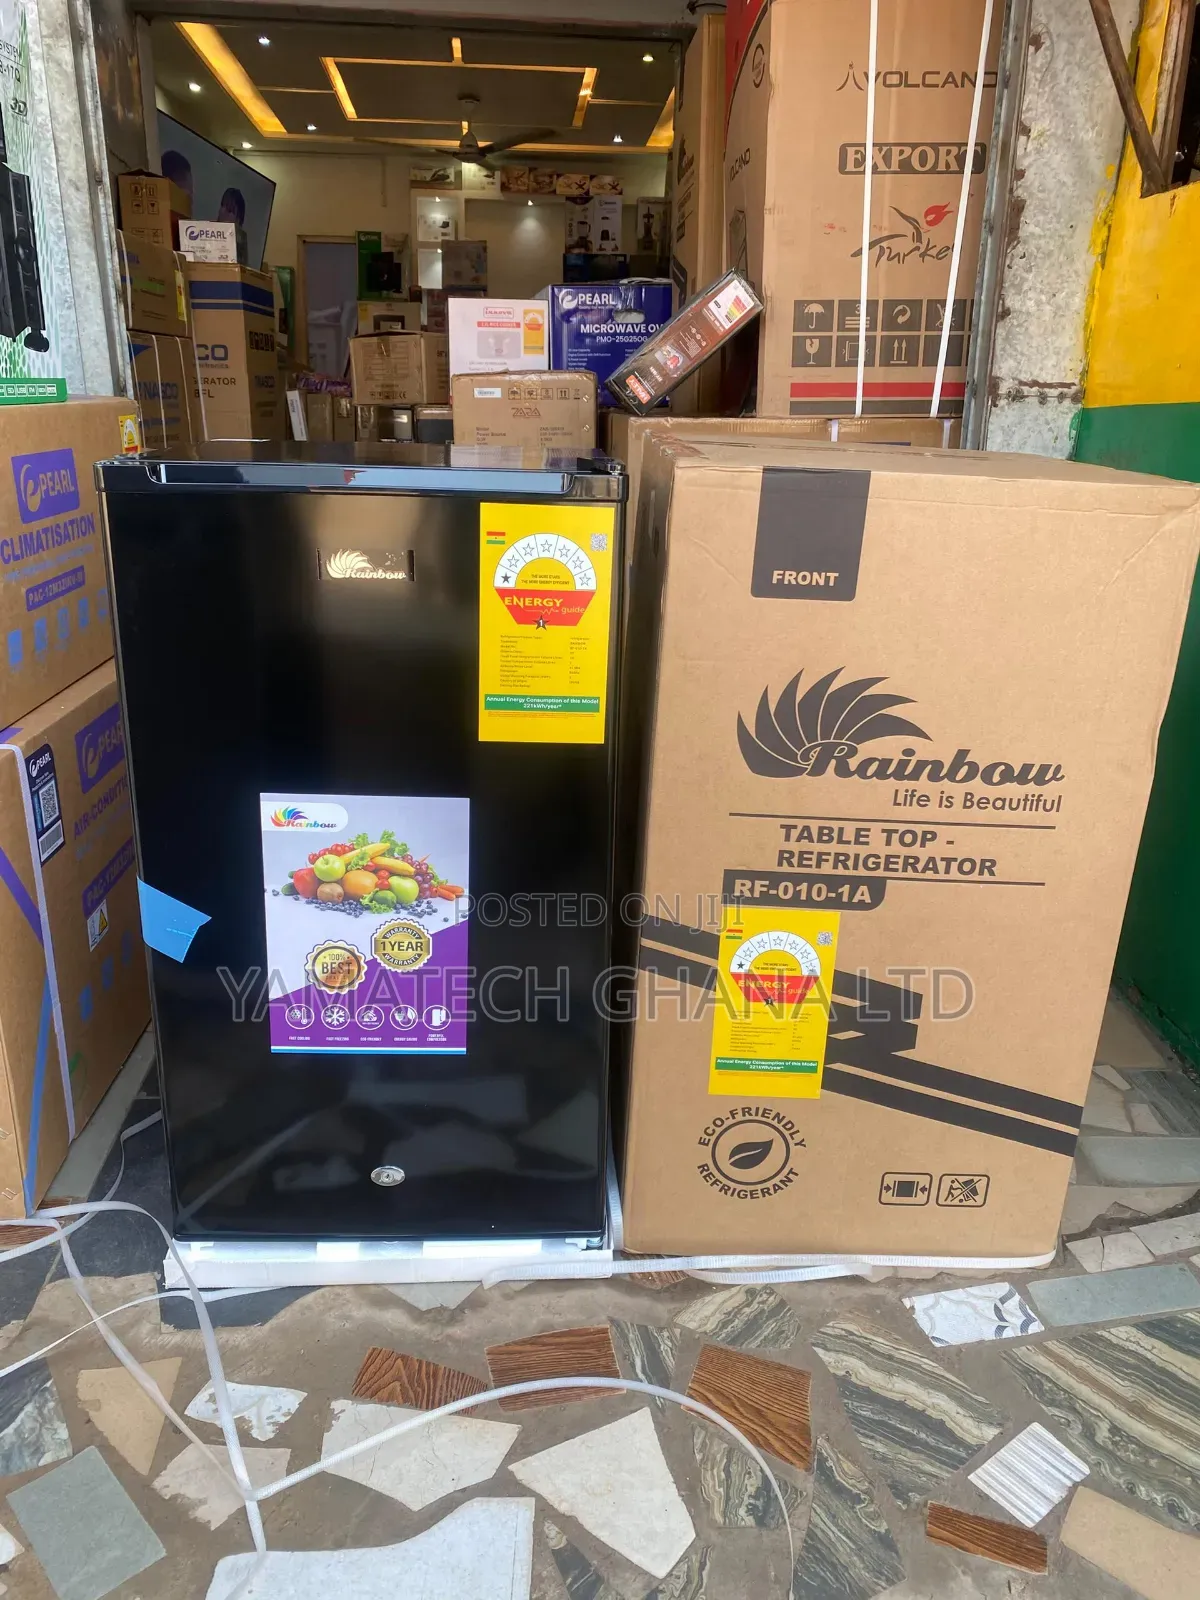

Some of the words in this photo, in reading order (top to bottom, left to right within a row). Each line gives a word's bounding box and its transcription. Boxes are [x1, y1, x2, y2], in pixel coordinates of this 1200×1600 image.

[863, 71, 997, 88] VOLCANO
[844, 145, 982, 172] EXPORT
[200, 230, 227, 239] PEARL
[579, 293, 617, 305] PEARL
[580, 324, 646, 334] MICROWAVE
[39, 468, 75, 498] PEARL
[0, 513, 96, 565] CLIMATISATION
[343, 568, 407, 580] Rainbow
[772, 570, 839, 587] FRONT
[504, 595, 563, 608] ENERGY
[561, 606, 585, 615] guide
[37, 752, 51, 769] PEARL
[797, 740, 1065, 787] Rainbow
[892, 788, 930, 808] Life
[938, 790, 954, 809] is
[962, 791, 1063, 813] Beautiful
[284, 819, 337, 828] Rainbow
[779, 823, 871, 846] TABLE
[881, 828, 938, 848] TOP
[776, 849, 997, 877] REFRIGERATOR
[734, 879, 872, 904] RF-010-1A
[385, 927, 420, 938] WARRANTY
[380, 941, 386, 952] 1
[388, 941, 424, 952] YEAR
[322, 962, 352, 974] BEST
[385, 954, 420, 966] WARRANTY
[738, 979, 791, 990] ENERGY
[697, 1106, 807, 1149] ECO-FRIENDLY
[697, 1163, 800, 1200] REFRIGERANT
